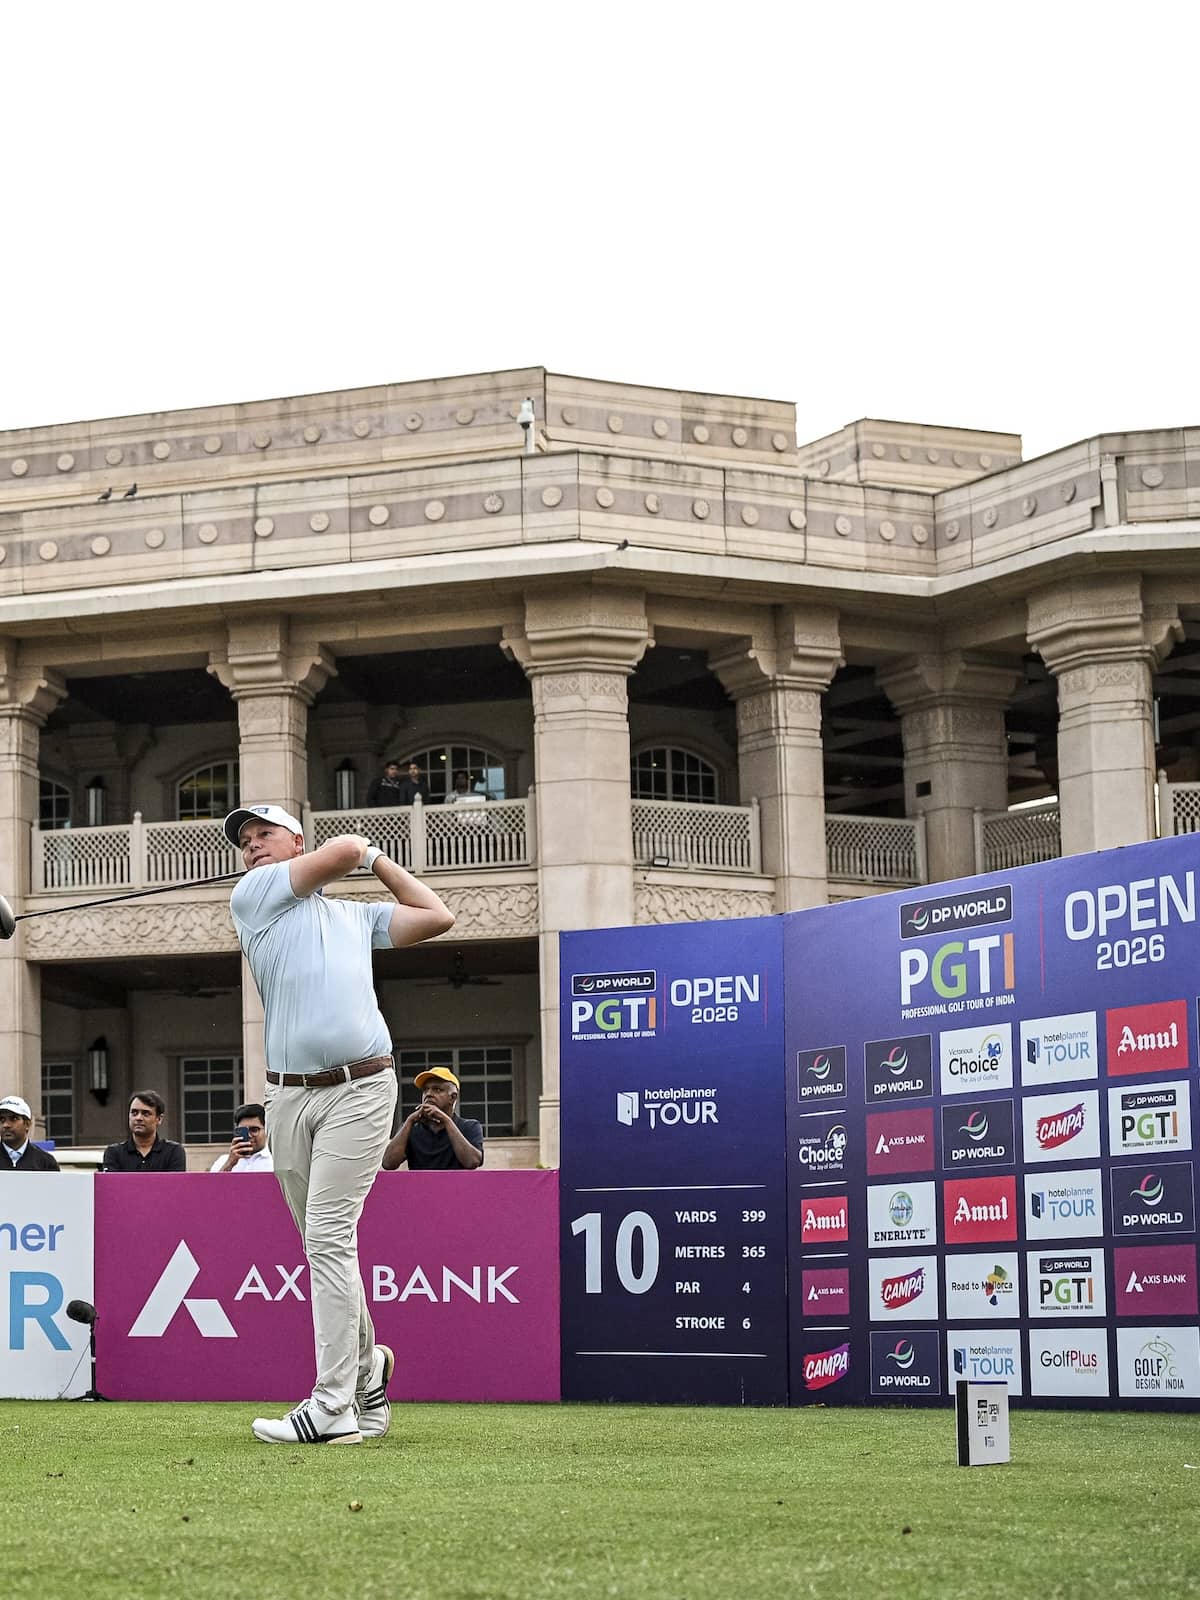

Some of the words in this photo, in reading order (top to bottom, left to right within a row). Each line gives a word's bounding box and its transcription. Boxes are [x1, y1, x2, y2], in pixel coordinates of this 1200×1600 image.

[931, 907, 951, 924] DP
[952, 897, 1006, 919] WORLD
[1065, 871, 1196, 941] OPEN
[1096, 934, 1166, 970] 2026
[900, 933, 1015, 1005] PGTI
[596, 979, 611, 988] DP
[612, 977, 651, 987] WORLD
[670, 974, 760, 1006] OPEN
[572, 997, 656, 1032] PGTI
[692, 1006, 739, 1023] 2026
[901, 1005, 947, 1019] PROFESSIONAL
[948, 1001, 965, 1013] GOLF
[967, 999, 984, 1010] TOUR
[985, 997, 994, 1007] OF
[996, 994, 1015, 1006] INDIA
[1044, 1031, 1088, 1043] hotelplanner
[1118, 1022, 1179, 1056] Amul
[1044, 1042, 1090, 1066] TOUR
[949, 1055, 999, 1075] Choice
[644, 1088, 716, 1100] hotelplanner
[801, 1087, 812, 1096] DP
[813, 1083, 843, 1095] WORLD
[874, 1084, 887, 1094] DP
[888, 1080, 923, 1092] WORLD
[644, 1101, 719, 1129] TOUR
[1040, 1111, 1081, 1140] CAMPA
[1122, 1112, 1178, 1141] PGTI
[889, 1137, 904, 1146] AXIS
[905, 1135, 926, 1144] BANK
[799, 1145, 843, 1163] Choice
[952, 1150, 966, 1160] DP
[967, 1146, 1005, 1158] WORLD
[1048, 1187, 1093, 1199] hotelplanner
[675, 1211, 717, 1222] YARDS
[742, 1211, 766, 1222] 399
[954, 1197, 1008, 1225] Amul
[1048, 1199, 1095, 1220] TOUR
[803, 1209, 846, 1232] Amul
[1123, 1214, 1141, 1226] DP
[1142, 1212, 1183, 1225] WORLD
[874, 1229, 926, 1241] ENERLYTE
[571, 1211, 659, 1294] 10
[675, 1247, 725, 1258] METRES
[742, 1246, 766, 1258] 365
[234, 1264, 306, 1301] AX
[373, 1265, 520, 1303] BANK
[675, 1282, 700, 1293] PAR
[742, 1282, 751, 1293] 4
[884, 1275, 922, 1301] CAMPA
[951, 1282, 969, 1290] Road
[972, 1282, 979, 1290] to
[1142, 1275, 1161, 1284] AXIS
[1163, 1274, 1186, 1284] BANK
[1040, 1278, 1093, 1304] PGTI
[675, 1317, 725, 1329] STROKE
[743, 1318, 751, 1329] 6
[970, 1346, 1013, 1356] hotelplanner
[1041, 1350, 1097, 1367] GolfPlus
[806, 1351, 848, 1379] CAMPA
[970, 1357, 1015, 1377] TOUR
[1135, 1358, 1162, 1376] GOLF
[880, 1376, 894, 1386] DP
[895, 1375, 930, 1386] WORLD
[1136, 1379, 1160, 1389] DESIGN
[1166, 1379, 1184, 1389] INDIA
